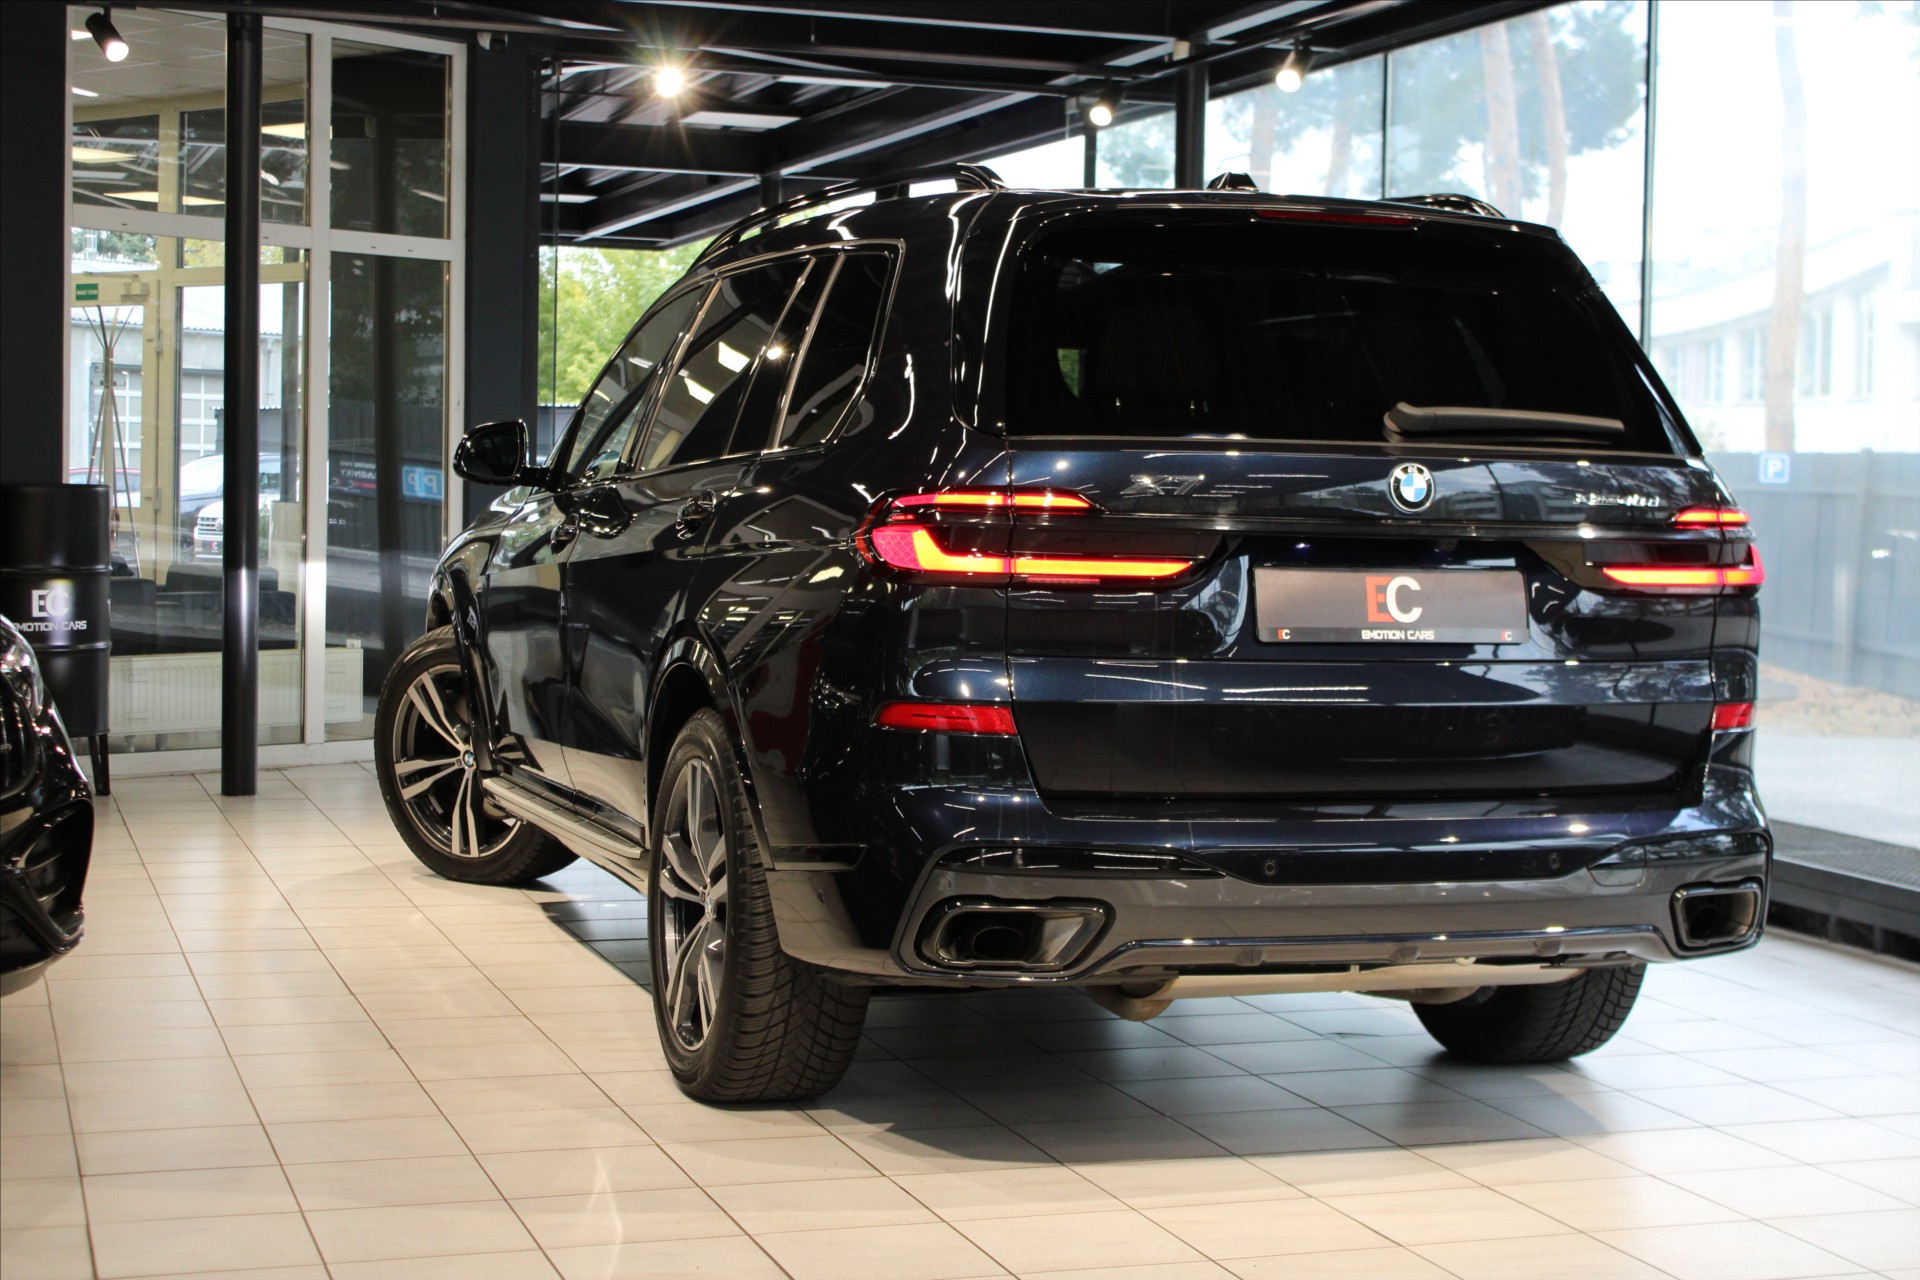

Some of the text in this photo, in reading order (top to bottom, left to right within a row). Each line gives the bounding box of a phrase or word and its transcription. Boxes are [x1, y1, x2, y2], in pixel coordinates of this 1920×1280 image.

[1768, 459, 1783, 478] P
[1120, 474, 1205, 495] X7
[31, 589, 69, 618] EC
[1365, 576, 1423, 623] EC
[61, 620, 88, 630] CARS
[1361, 629, 1436, 640] EMOTION CARS
